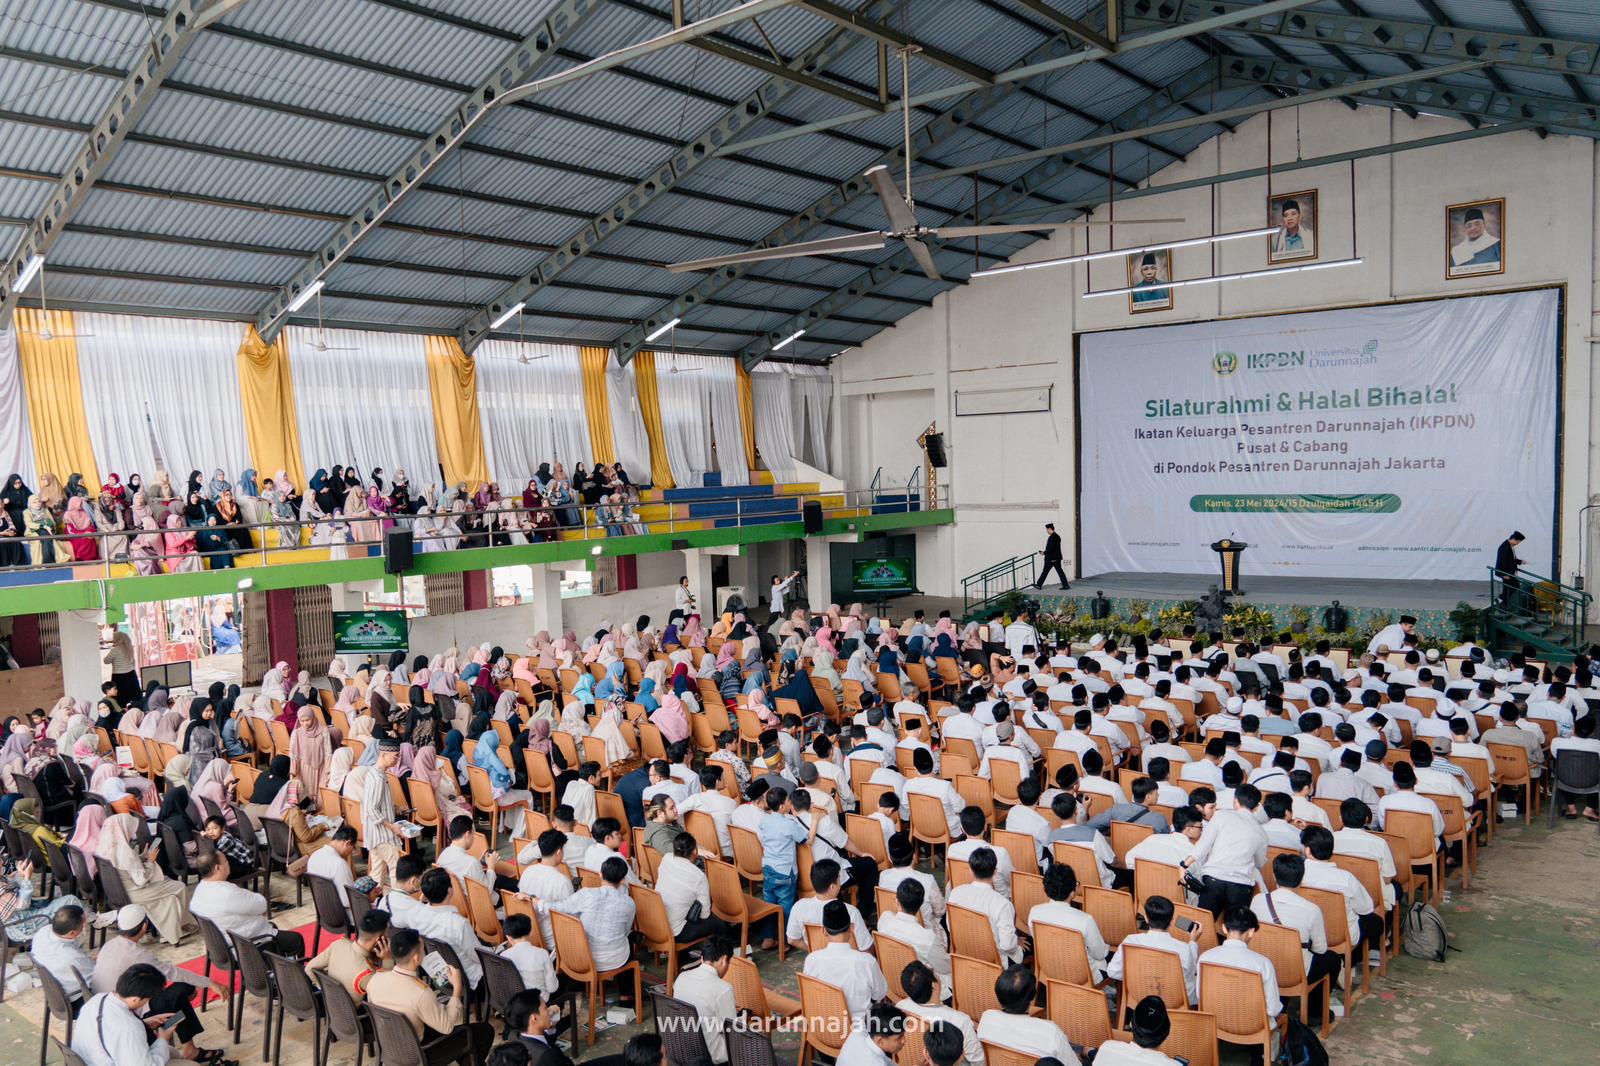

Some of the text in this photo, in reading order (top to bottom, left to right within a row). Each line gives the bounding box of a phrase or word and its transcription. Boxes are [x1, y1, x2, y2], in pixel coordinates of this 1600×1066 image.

[1247, 350, 1304, 369] IKPDN
[1309, 348, 1360, 358] Universitas
[1309, 353, 1377, 369] Darunnajah
[1145, 383, 1457, 418] Silaturahmi & Halal Bihalal
[1134, 413, 1475, 440] Ikatan Keluarga Pesantren Darunnajah (IKPDN)
[1237, 440, 1348, 454] Pusat & Cabang
[1153, 457, 1446, 474] di Pondok Pesantren Darunnajah Jakarta
[1234, 499, 1245, 507] 23
[1246, 499, 1262, 507] Mei
[1375, 499, 1383, 508] H
